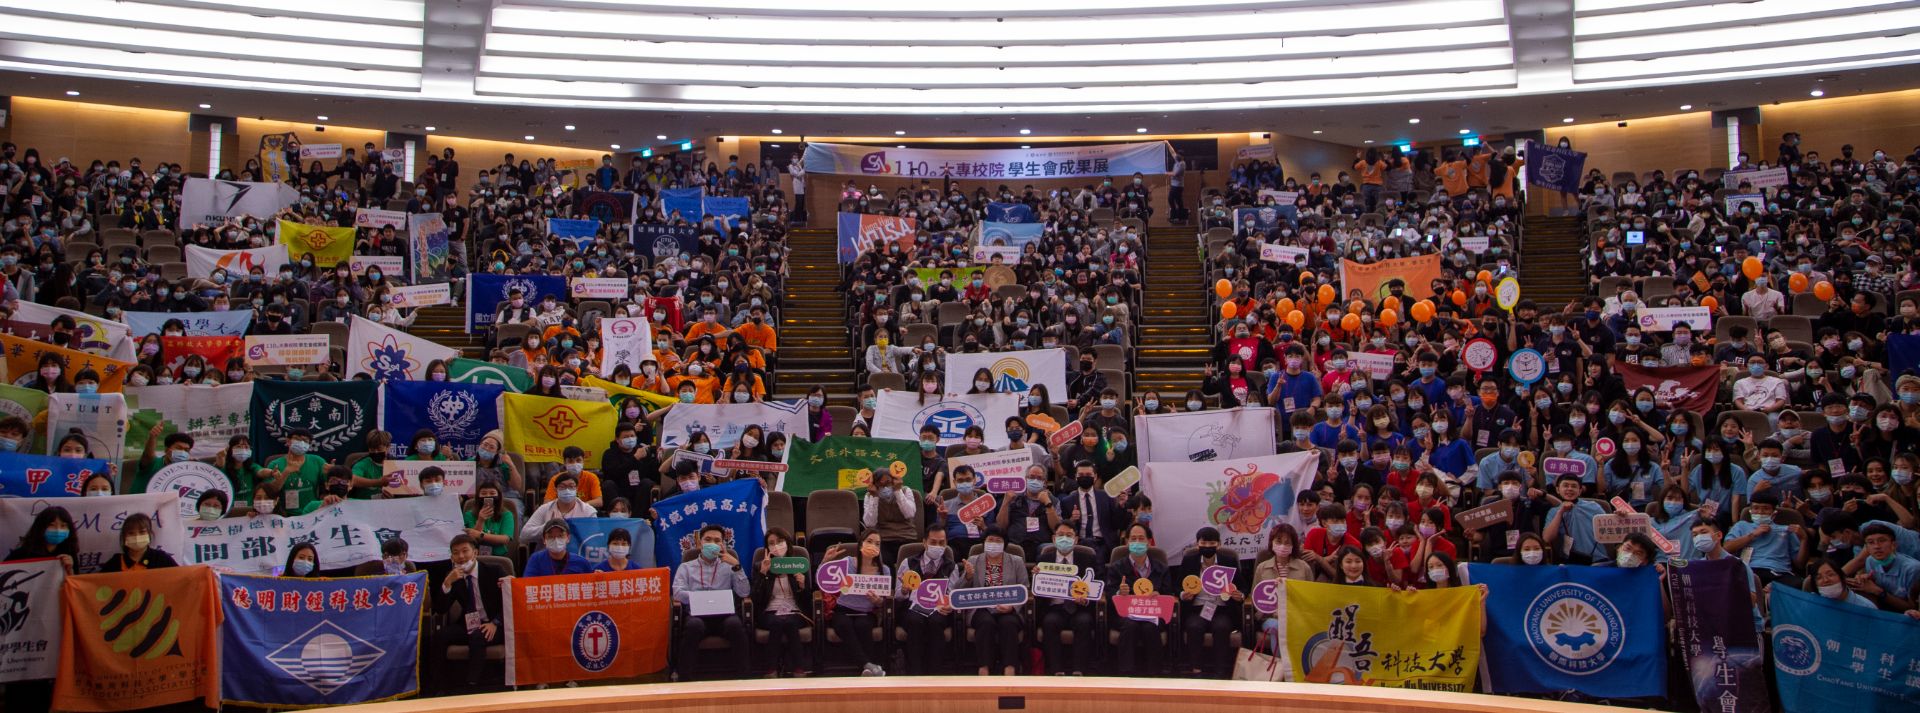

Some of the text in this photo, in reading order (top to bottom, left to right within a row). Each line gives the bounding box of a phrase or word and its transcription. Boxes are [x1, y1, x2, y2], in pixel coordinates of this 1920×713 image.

[1008, 158, 1109, 177] 學生會成果展
[66, 403, 112, 413] YUMT
[793, 563, 805, 571] help
[232, 581, 419, 613] 德明財經科技大學
[525, 576, 661, 603] 聖母醫護管理專科學校
[1540, 588, 1584, 608] UNIVERSITY
[1584, 593, 1598, 602] OF
[1595, 600, 1620, 648] TECHNOLOGY
[1381, 645, 1466, 678] 科技大學
[1712, 635, 1739, 713] 學生會
